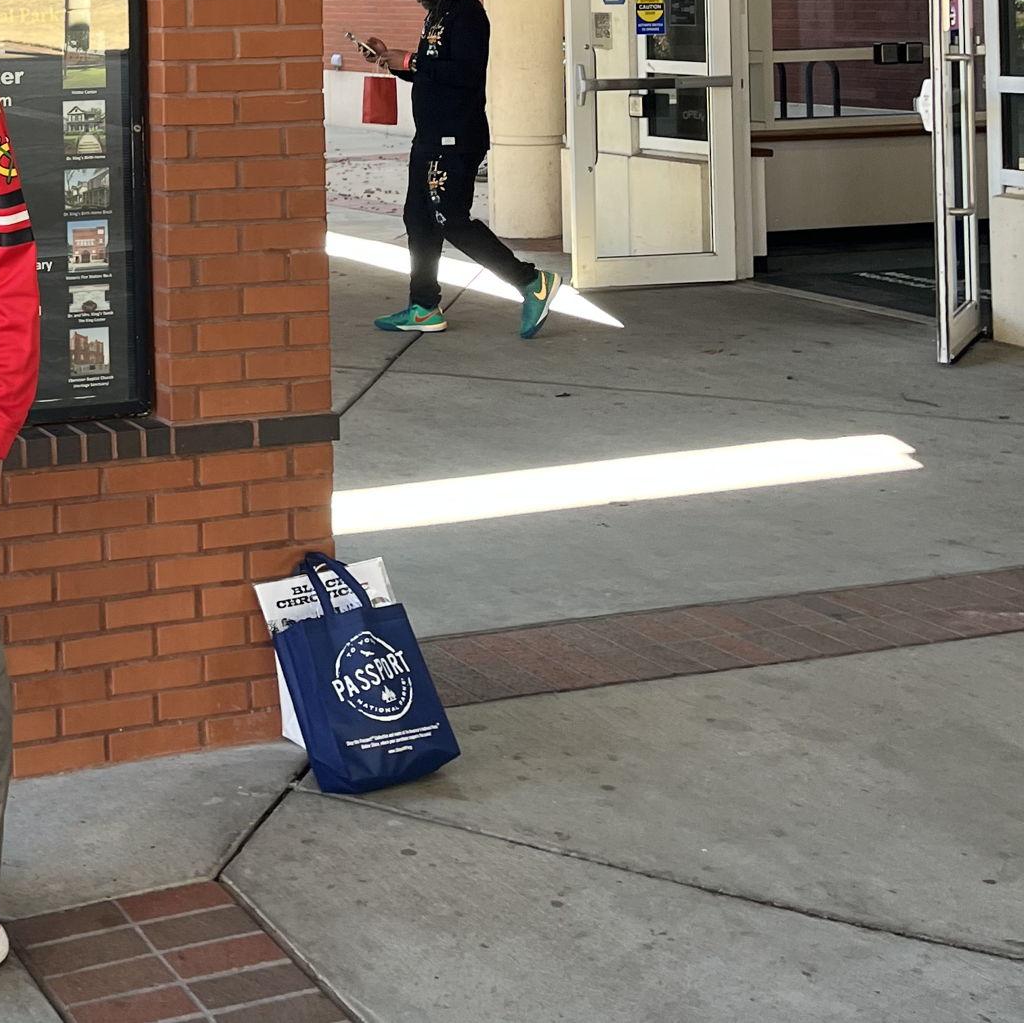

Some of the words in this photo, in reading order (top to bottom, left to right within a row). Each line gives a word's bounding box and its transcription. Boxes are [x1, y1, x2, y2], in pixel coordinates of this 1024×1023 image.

[291, 578, 345, 596] BLC
[331, 649, 411, 703] PASSPORT
[357, 698, 400, 714] NATIONAL
